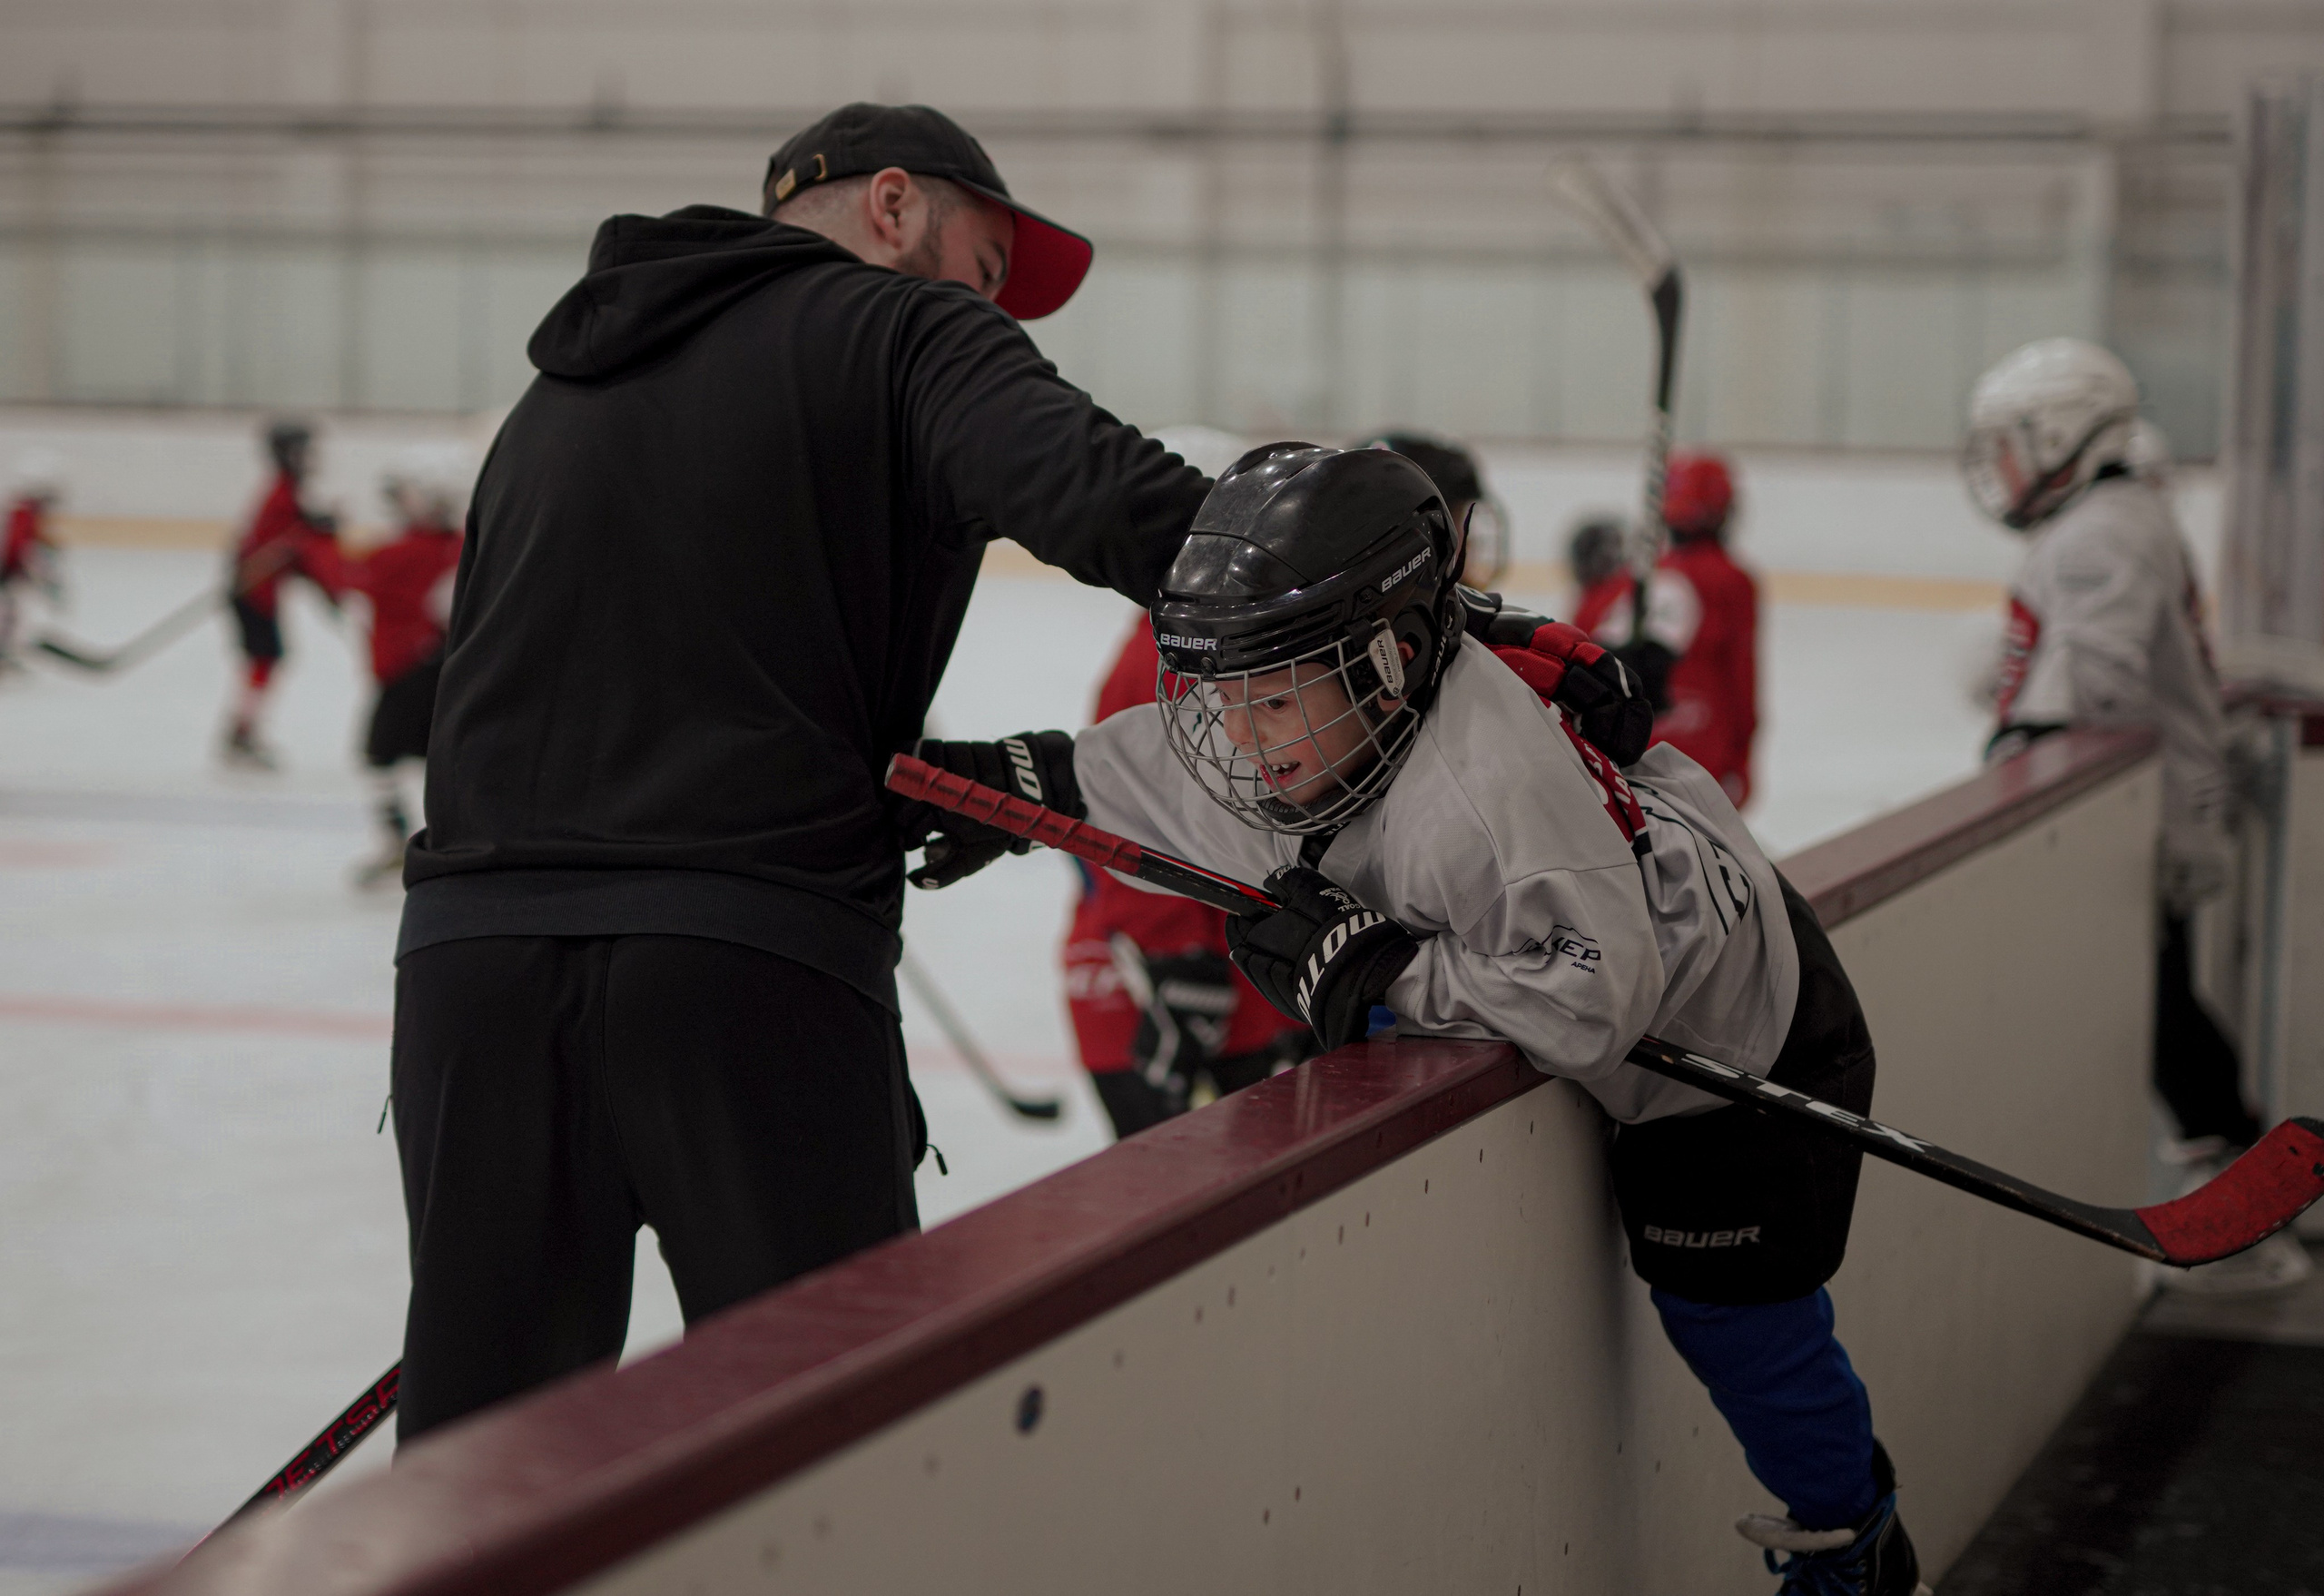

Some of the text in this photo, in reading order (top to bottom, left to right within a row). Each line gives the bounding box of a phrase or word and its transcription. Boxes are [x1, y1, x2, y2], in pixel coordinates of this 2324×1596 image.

[1381, 546, 1432, 593] BAUER
[1159, 634, 1217, 651] BAUER
[1376, 639, 1393, 684] BAUER
[1296, 911, 1387, 1027] MOTIO
[1571, 961, 1596, 974] АРЕНА
[1681, 1053, 1935, 1152] STEX
[1644, 1224, 1761, 1248] BAUER
